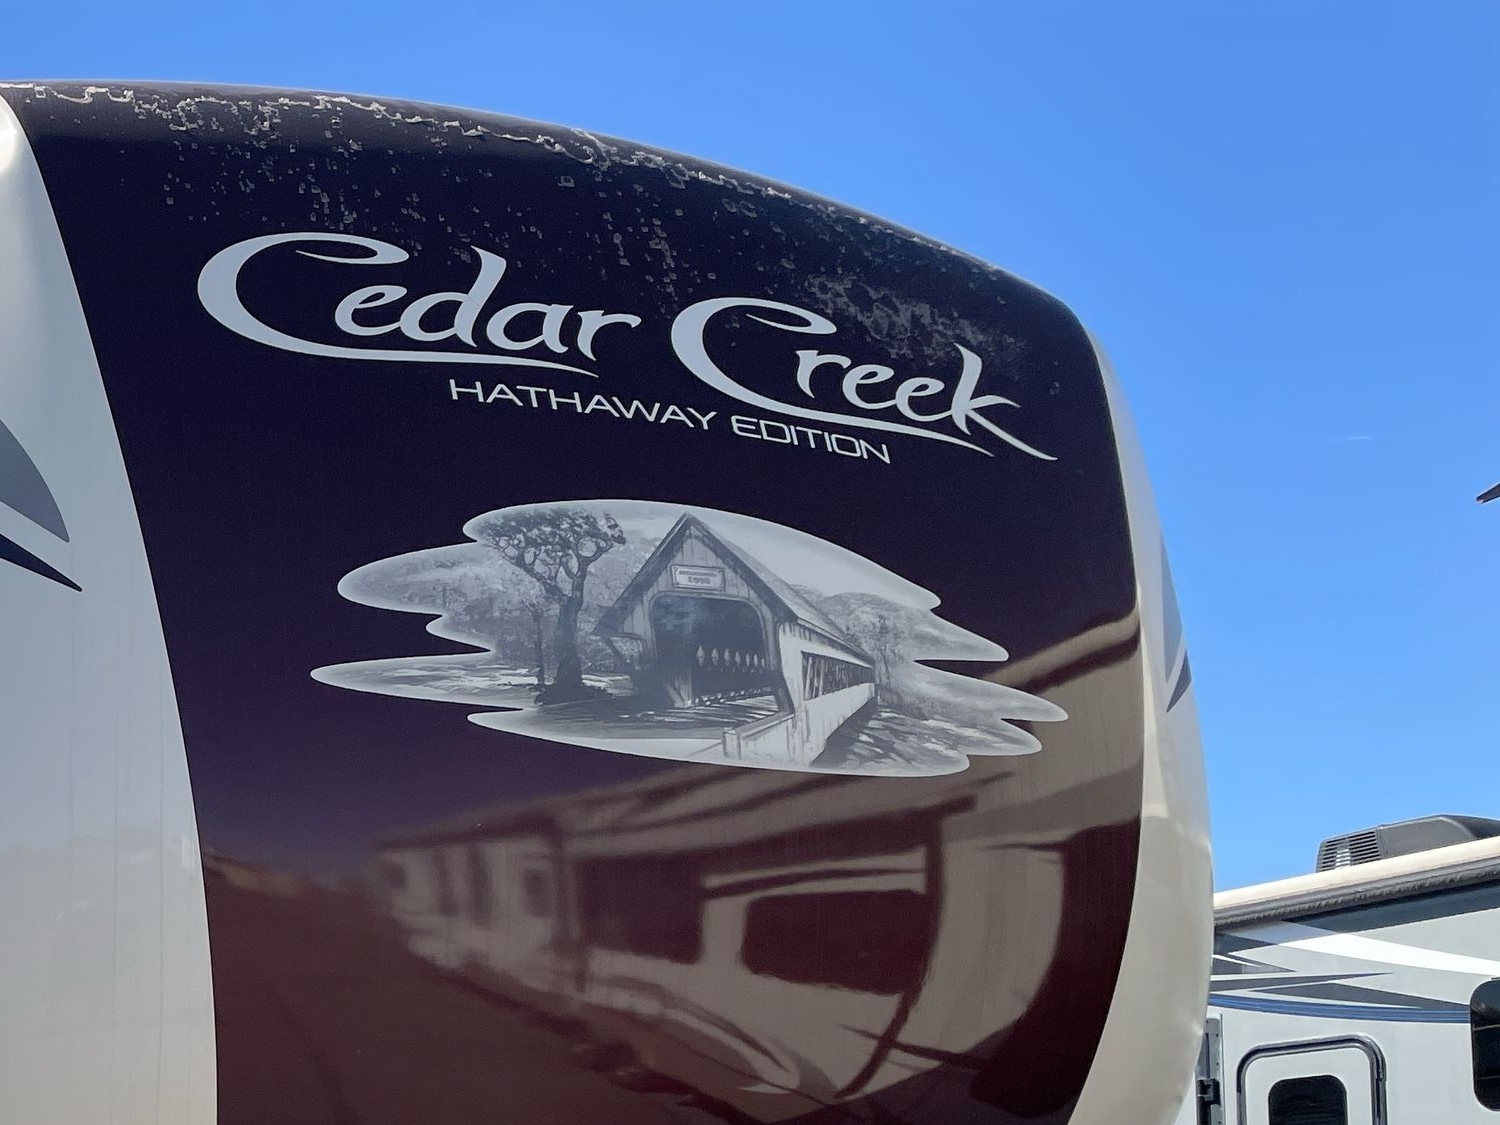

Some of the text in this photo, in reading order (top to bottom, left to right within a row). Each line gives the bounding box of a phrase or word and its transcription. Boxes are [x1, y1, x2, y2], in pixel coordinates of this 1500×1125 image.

[196, 231, 1059, 462] Cedar Creek
[448, 378, 892, 465] HATHAWAY EDITION
